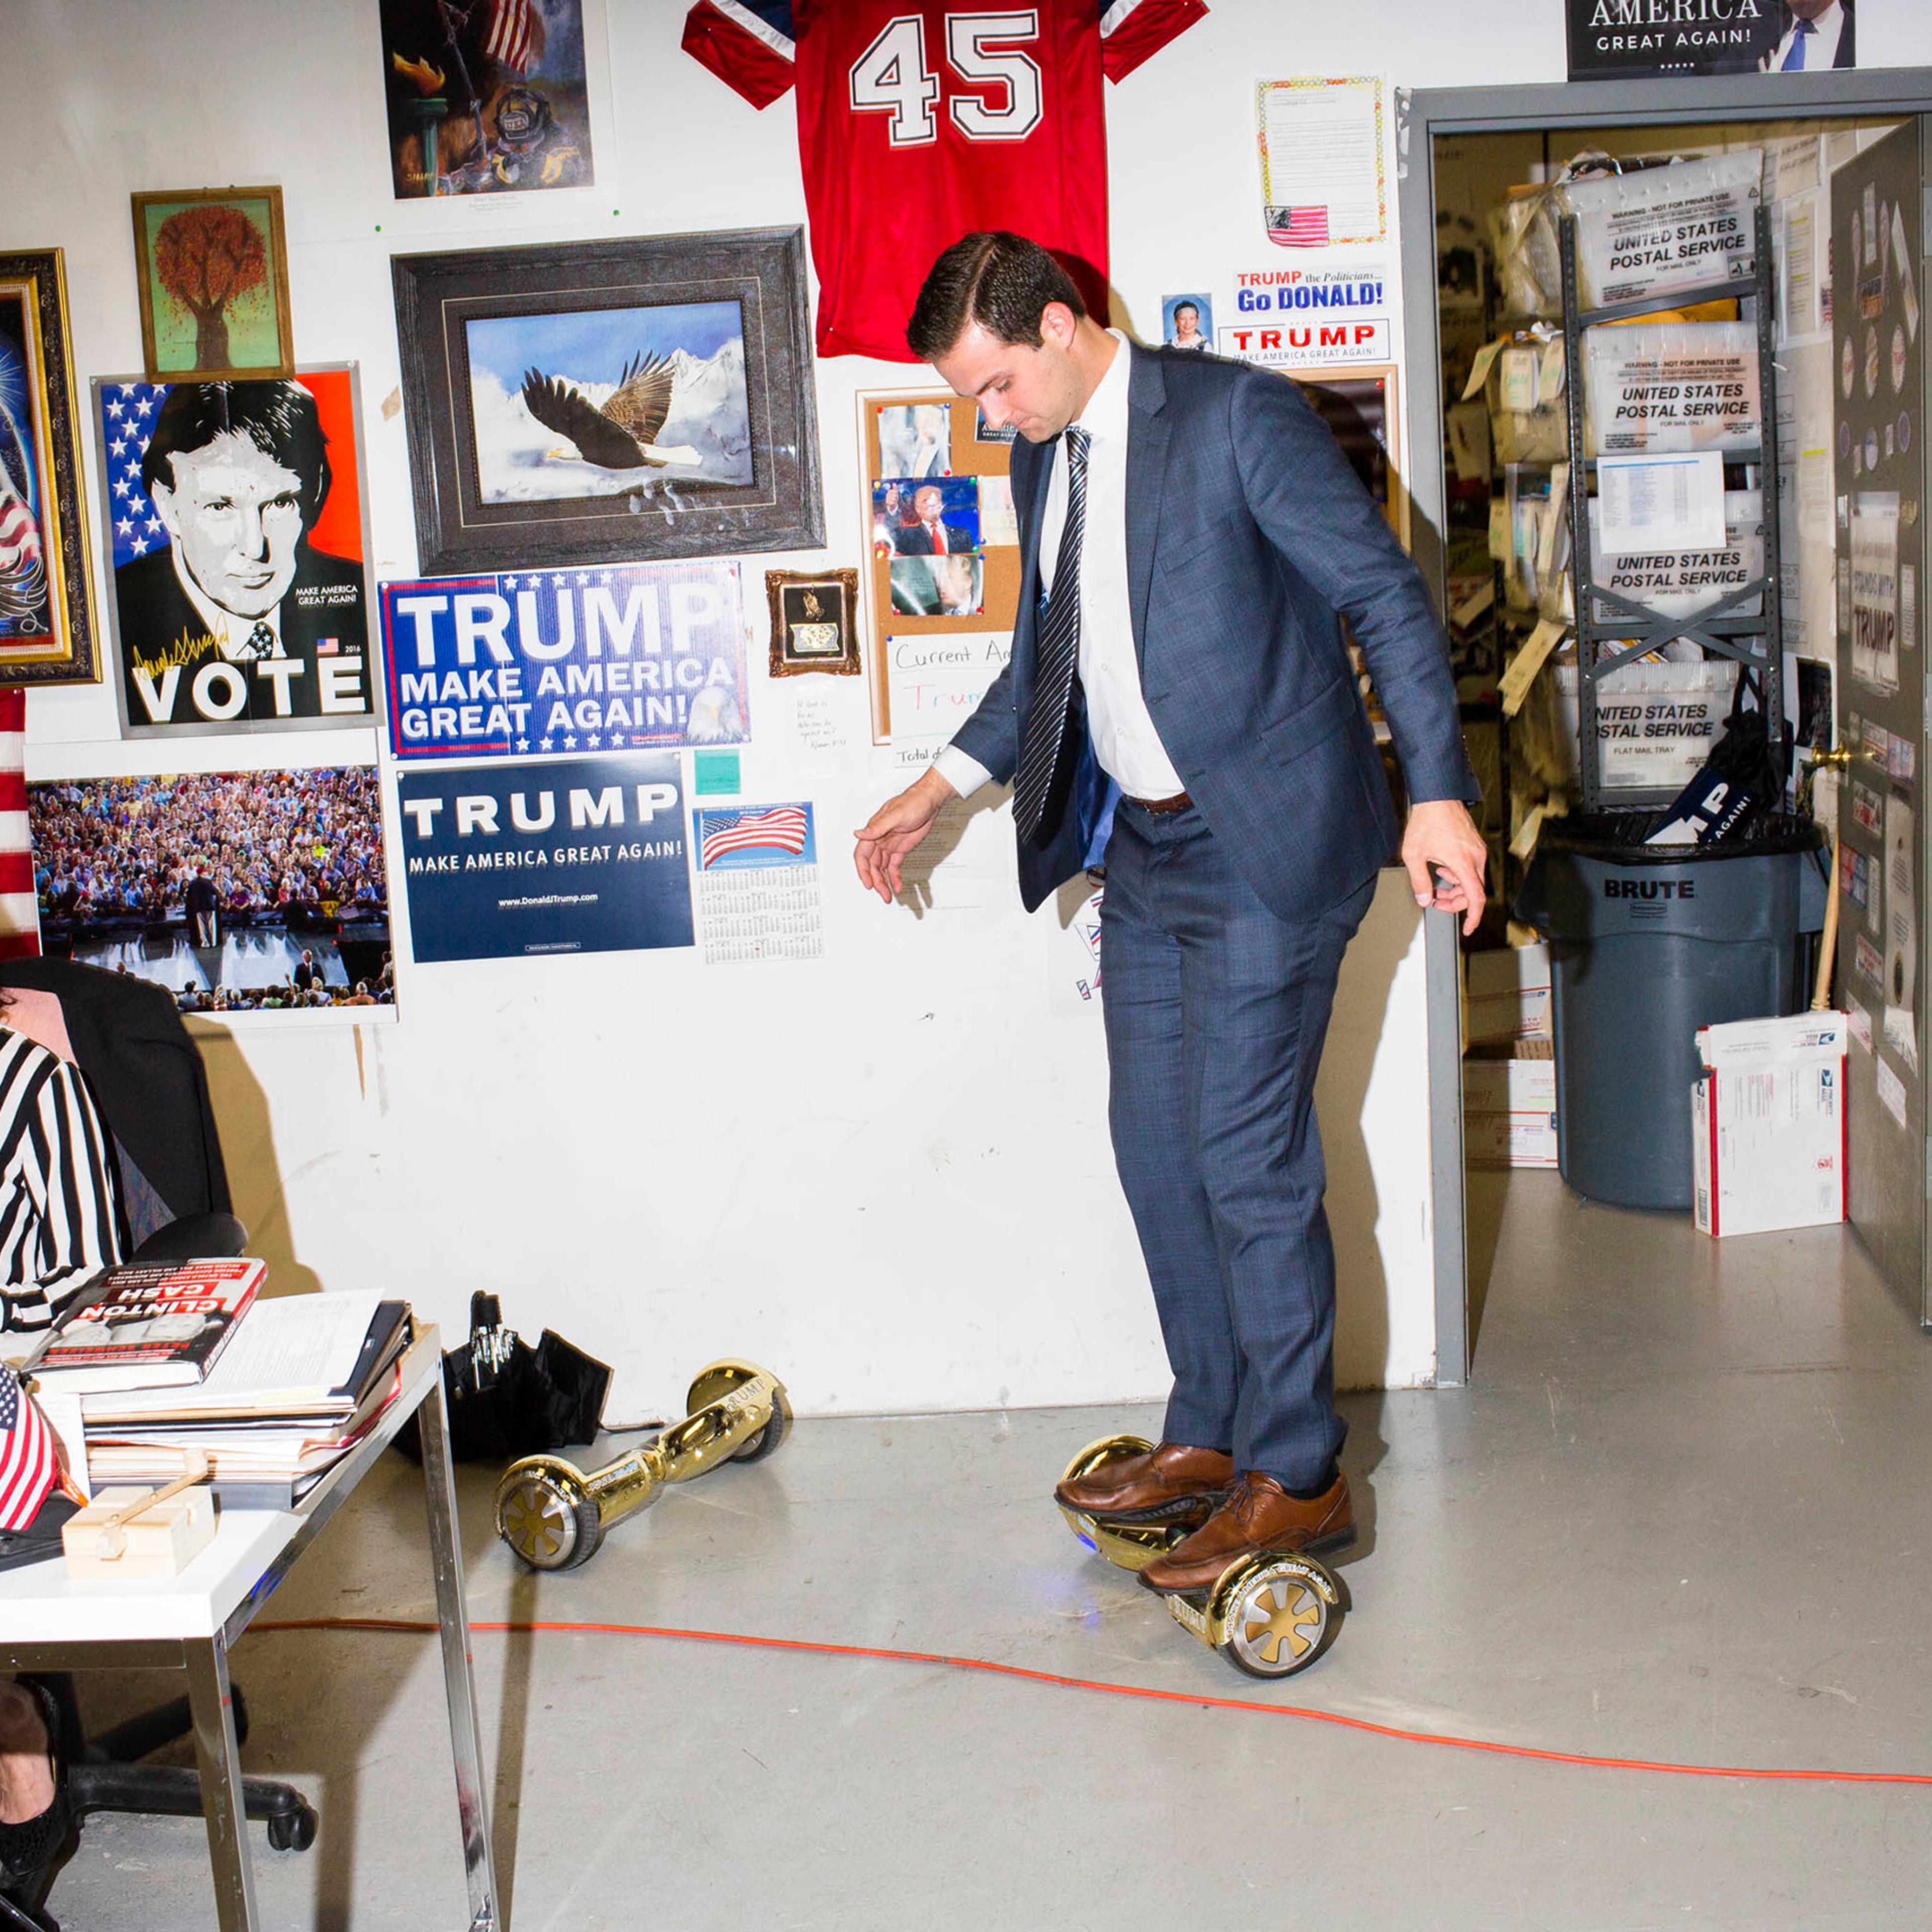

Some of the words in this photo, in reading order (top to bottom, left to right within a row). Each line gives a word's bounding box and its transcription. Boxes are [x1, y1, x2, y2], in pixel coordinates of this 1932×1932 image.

[1588, 0, 1762, 26] AMERICA
[1597, 34, 1665, 50] GREAT
[1675, 29, 1750, 46] AGAIN!
[849, 9, 1043, 146] 45
[1614, 230, 1671, 251] UNITED
[1676, 218, 1737, 240] STATES
[1611, 250, 1672, 270] POSTAL
[1678, 234, 1745, 257] SERVICE
[1238, 271, 1302, 286] TRUMP
[1306, 273, 1321, 283] the
[1238, 289, 1271, 312] Go
[1278, 282, 1383, 310] DONALD!
[1233, 326, 1375, 351] TRUMP
[1263, 351, 1306, 361] AMERICA
[1310, 350, 1340, 358] GREAT
[1342, 348, 1376, 357] AGAIN!
[1623, 386, 1679, 400] UNITED
[1684, 384, 1743, 397] STATES
[1616, 404, 1677, 419] POSTAL
[1683, 401, 1749, 416] SERVICE
[1617, 555, 1675, 570] UNITED
[1679, 552, 1740, 567] STATES
[1611, 574, 1673, 588] POSTAL
[1678, 570, 1747, 585] SERVICE
[296, 586, 319, 597] MAKE
[321, 584, 358, 595] AMERICA
[298, 595, 326, 605] GREAT
[328, 593, 357, 604] AGAIN!
[397, 582, 721, 667] TRUMP
[1855, 604, 1895, 654] TRUMP
[345, 645, 361, 653] 2016
[896, 644, 971, 669] Current
[132, 656, 365, 723] VOTE
[401, 667, 522, 703] MAKE
[537, 657, 734, 695] AMERICA
[402, 702, 531, 739] GREAT
[547, 694, 687, 732] AGAIN!
[1596, 706, 1642, 720] NITED
[1645, 704, 1708, 719] STATES
[1644, 722, 1714, 737] SERVICE
[896, 748, 929, 762] Total
[1614, 747, 1633, 755] FLAT
[1655, 746, 1675, 754] TRAY
[404, 783, 679, 837] TRUMP
[1715, 796, 1751, 839] AGAIN!
[409, 854, 460, 873] MAKE
[465, 850, 548, 869] AMERICA
[554, 845, 612, 864] GREAT
[618, 840, 682, 860] AGAIN!
[1604, 879, 1695, 899] BRUTE
[499, 892, 598, 908] www.DonaldJTrump.com
[118, 1283, 206, 1301] CASH
[79, 1299, 219, 1319] CLINTON
